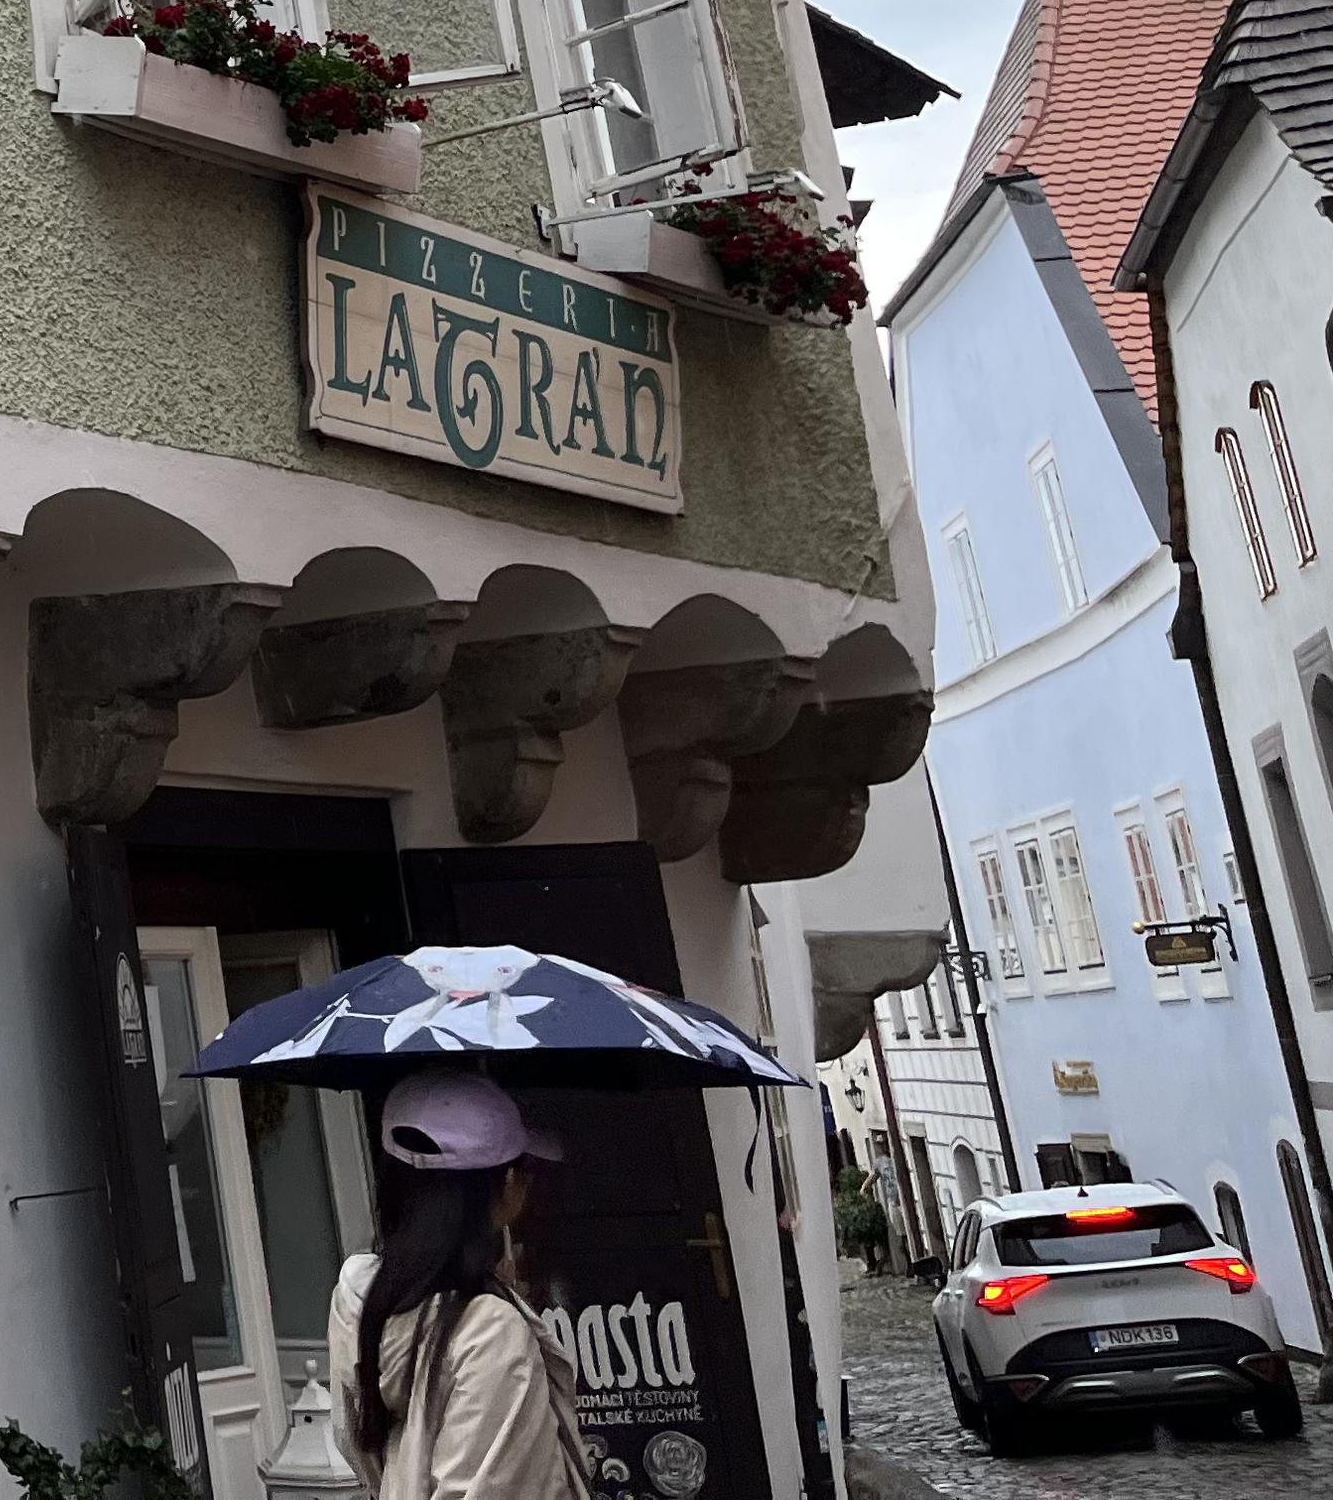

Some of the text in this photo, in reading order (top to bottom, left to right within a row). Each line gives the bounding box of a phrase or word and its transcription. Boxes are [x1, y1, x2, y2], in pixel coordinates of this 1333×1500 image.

[330, 206, 659, 352] PIZZERIA
[1108, 1325, 1174, 1345] NDK 136
[577, 1408, 634, 1426] TALSKÉ
